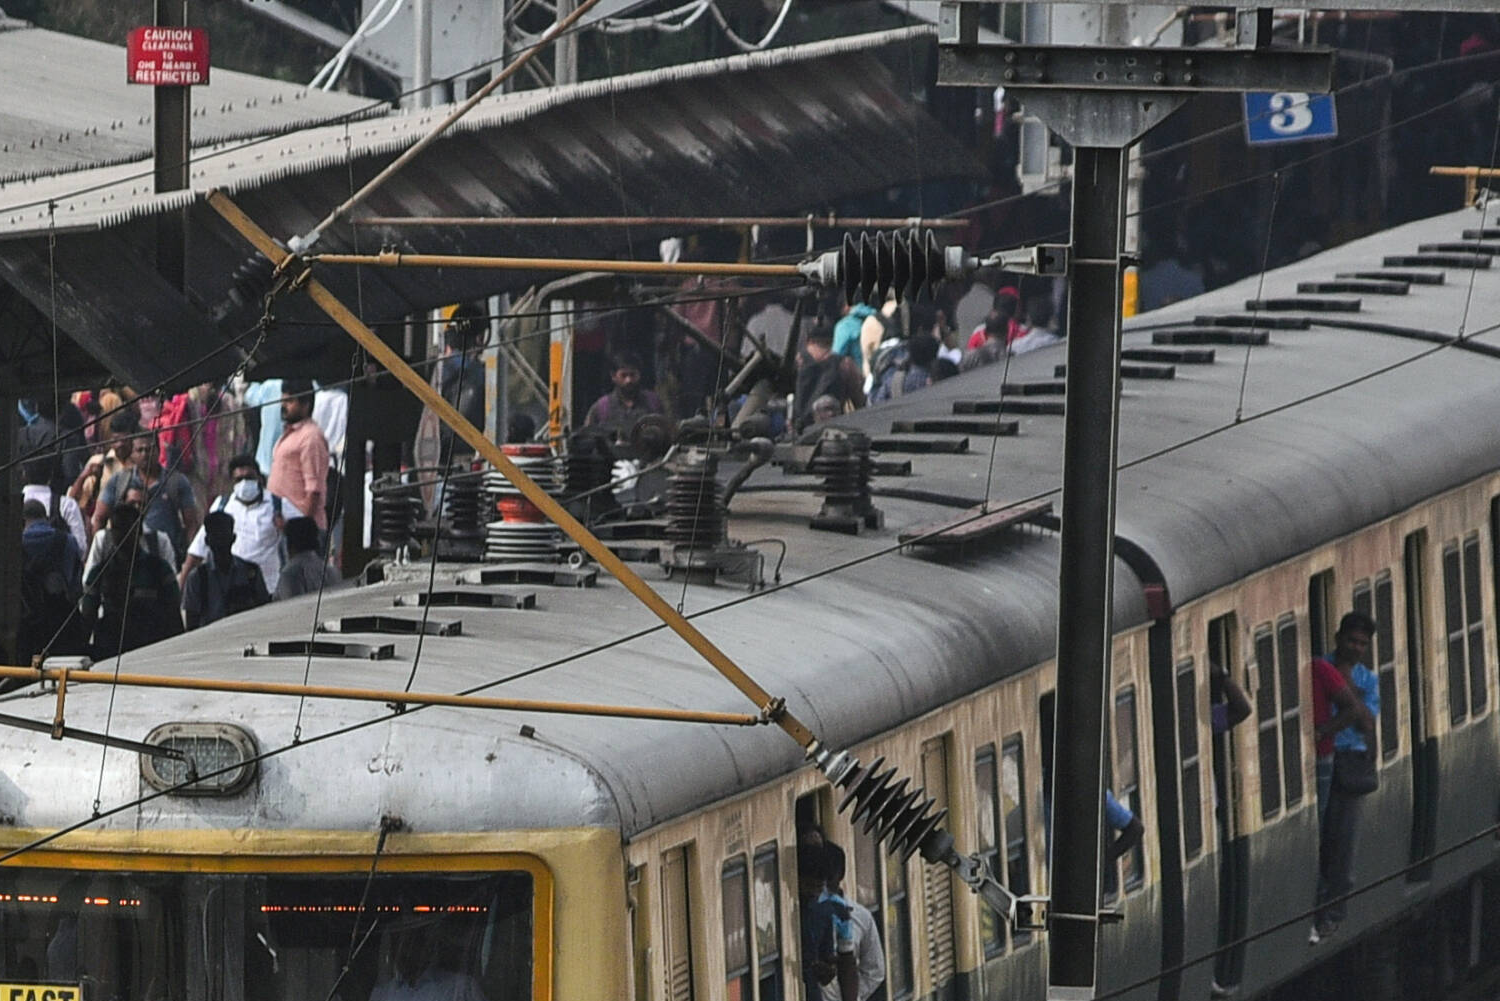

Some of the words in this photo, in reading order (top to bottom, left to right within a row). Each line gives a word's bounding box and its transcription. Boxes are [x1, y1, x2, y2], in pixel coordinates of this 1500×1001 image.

[144, 29, 192, 41] CAUTION
[142, 41, 194, 52] CLEARANCE
[162, 51, 174, 60] TO
[135, 70, 200, 83] RESTRICTED
[1270, 92, 1313, 135] 3
